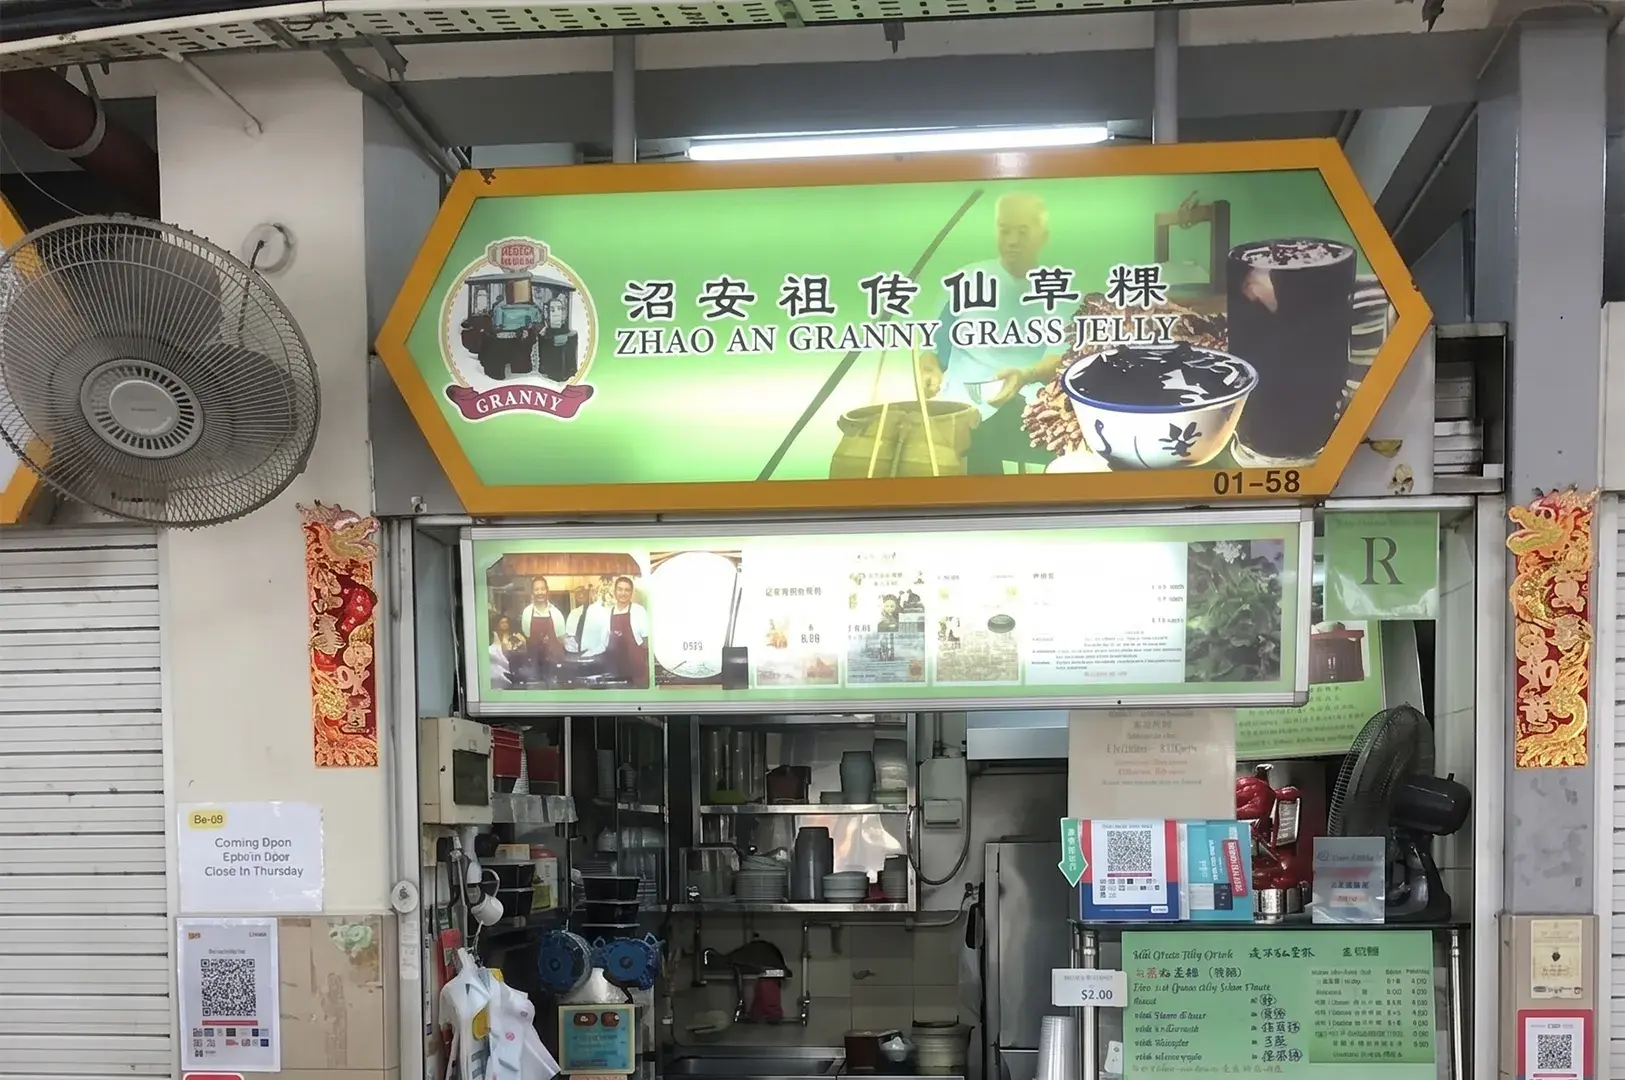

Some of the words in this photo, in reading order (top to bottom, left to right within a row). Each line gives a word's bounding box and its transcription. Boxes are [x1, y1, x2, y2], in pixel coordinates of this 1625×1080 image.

[617, 327, 715, 355] ZHAO
[727, 326, 776, 352] AN
[789, 323, 939, 351] GRANNY
[951, 318, 1063, 346] GRASS
[1075, 316, 1178, 348] JELLY
[476, 390, 564, 413] GRANNY
[1213, 469, 1300, 495] 01-58
[1360, 537, 1404, 585] R
[214, 837, 259, 849] Coming
[204, 866, 236, 877] Close
[253, 866, 304, 878] Thursday
[1081, 989, 1113, 1001] $2.00
